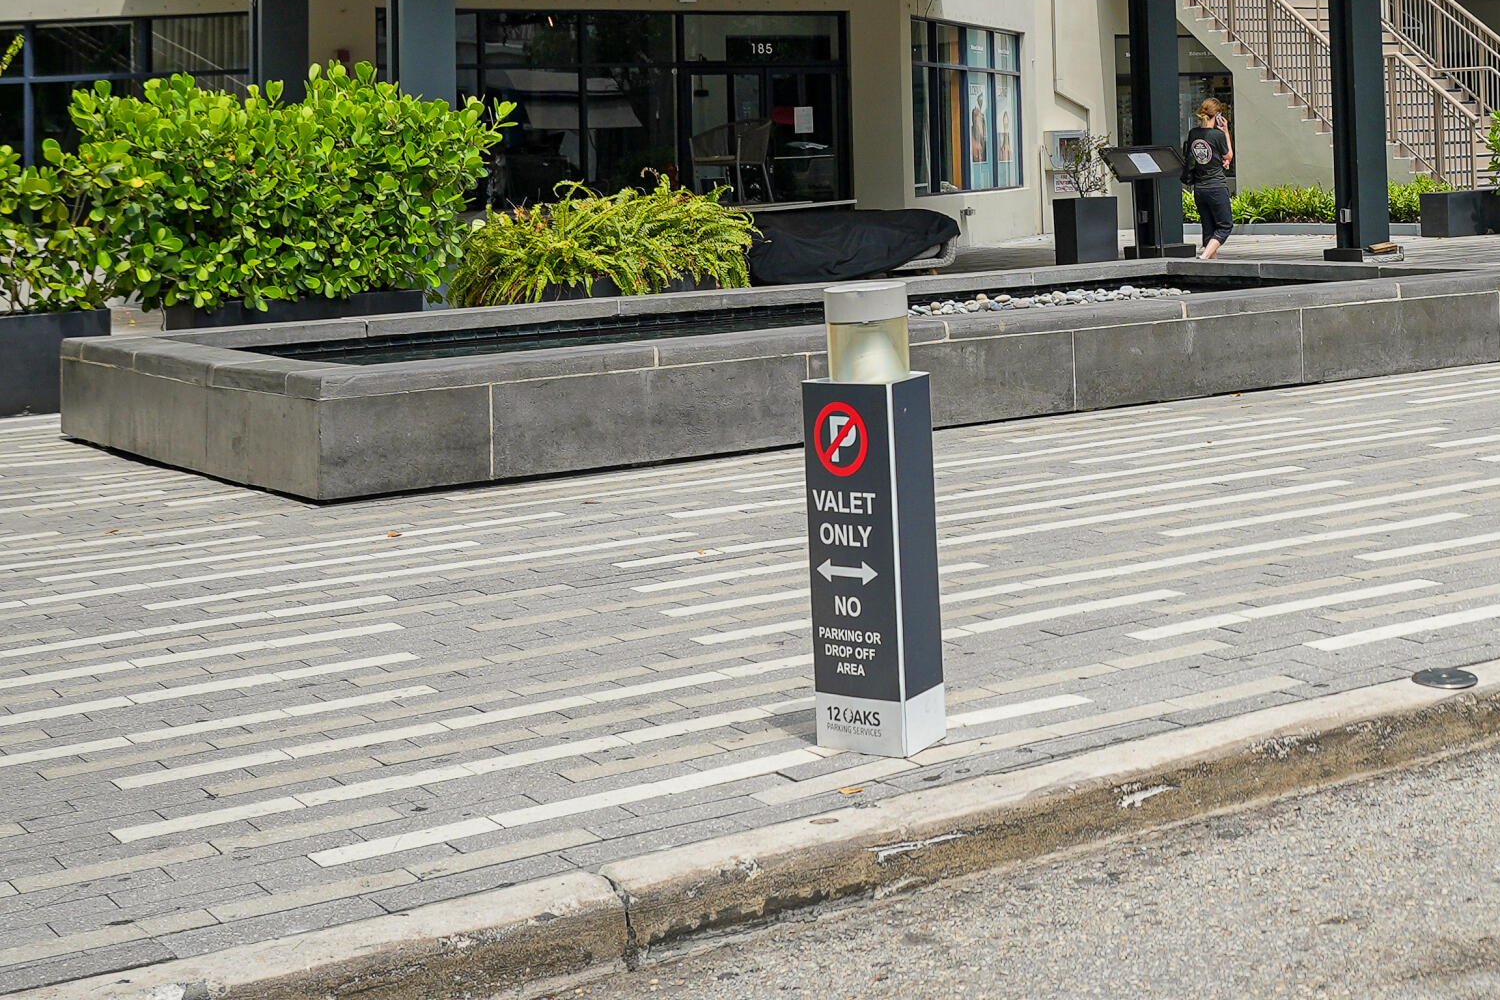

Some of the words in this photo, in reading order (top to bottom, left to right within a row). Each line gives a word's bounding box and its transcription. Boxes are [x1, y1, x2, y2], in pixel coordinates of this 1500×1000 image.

[751, 43, 773, 54] 185
[812, 489, 876, 515] VALET
[819, 522, 873, 548] ONLY
[834, 595, 862, 618] NO
[818, 626, 863, 643] PARKING
[865, 631, 882, 645] OR
[824, 643, 853, 658] DROP
[855, 648, 876, 661] OFF
[836, 661, 866, 677] AREA
[827, 706, 841, 722] 12
[843, 706, 881, 727] OAKS
[826, 722, 852, 734] PARKING
[852, 724, 882, 738] SERVICES
